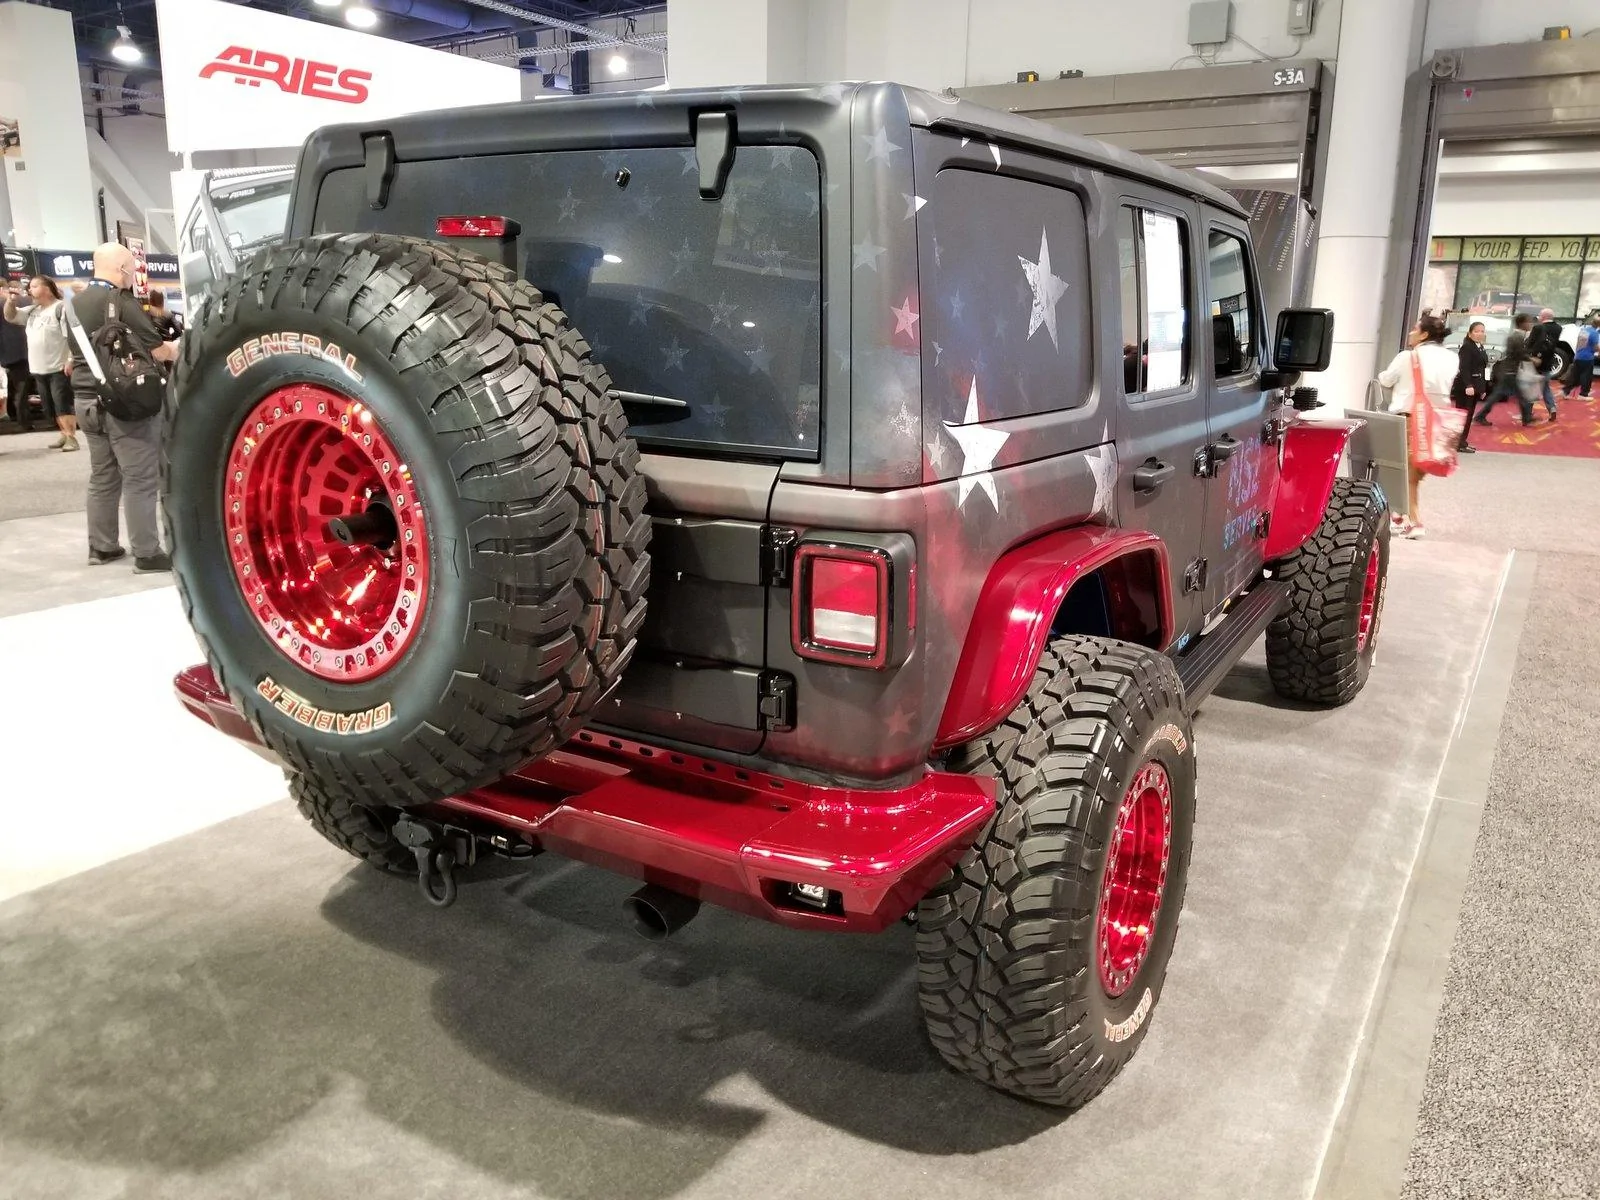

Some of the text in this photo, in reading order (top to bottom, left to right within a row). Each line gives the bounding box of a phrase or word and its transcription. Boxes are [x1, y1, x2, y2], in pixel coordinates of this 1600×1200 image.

[199, 45, 373, 104] ARIES
[1273, 68, 1304, 86] S-3A
[146, 262, 178, 273] RIVEN
[1472, 241, 1511, 258] YOUR
[226, 332, 365, 386] GENERAL
[256, 676, 391, 735] GRABBER
[1103, 987, 1152, 1043] GENERAL
